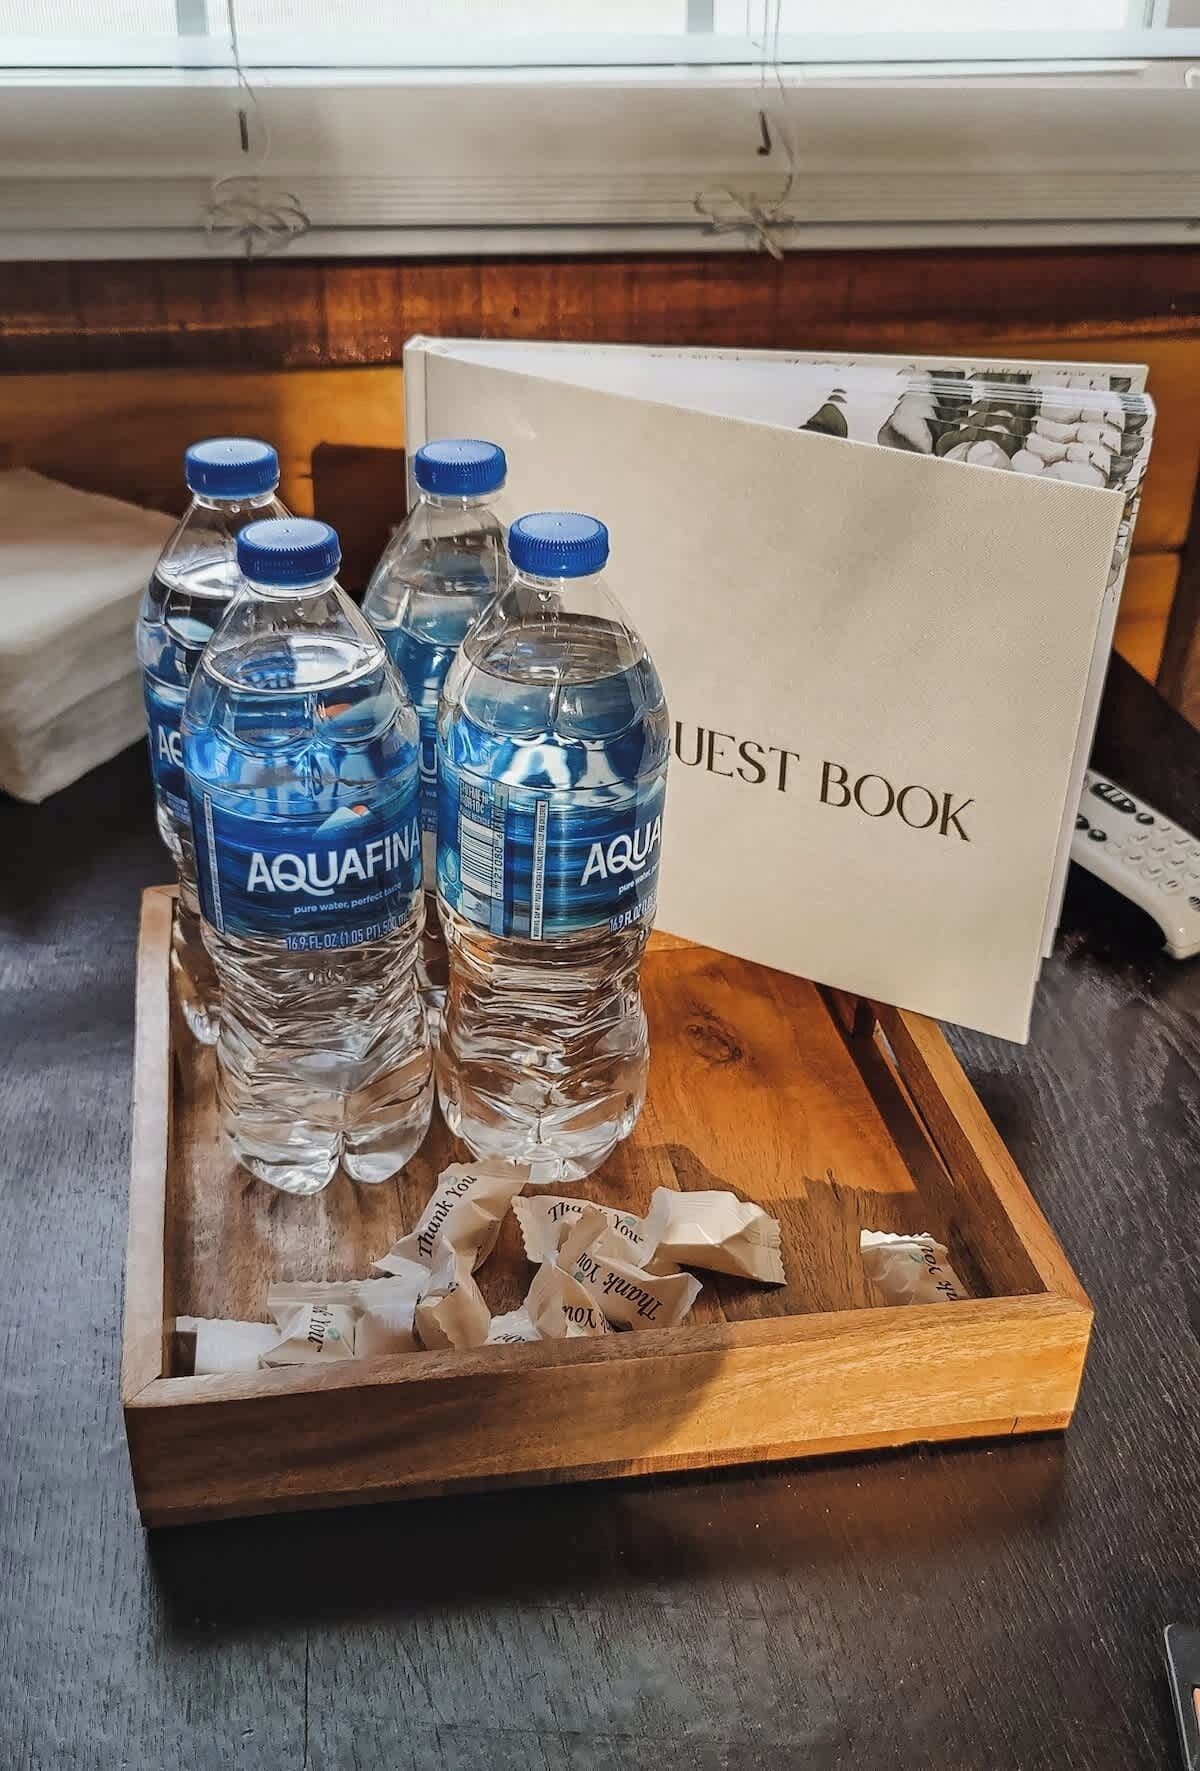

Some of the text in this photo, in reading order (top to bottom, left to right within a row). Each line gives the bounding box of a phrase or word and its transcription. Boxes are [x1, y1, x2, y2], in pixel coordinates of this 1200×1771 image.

[675, 721, 976, 842] UEST BOOK
[247, 816, 421, 896] AQUAFINA
[580, 815, 662, 887] AQUA
[294, 905, 318, 914] pure
[351, 893, 383, 908] perfect
[418, 1174, 478, 1259] Thank You
[613, 1213, 645, 1245] You
[576, 1252, 663, 1321] Thank You
[921, 1245, 943, 1276] You
[562, 1305, 597, 1329] You
